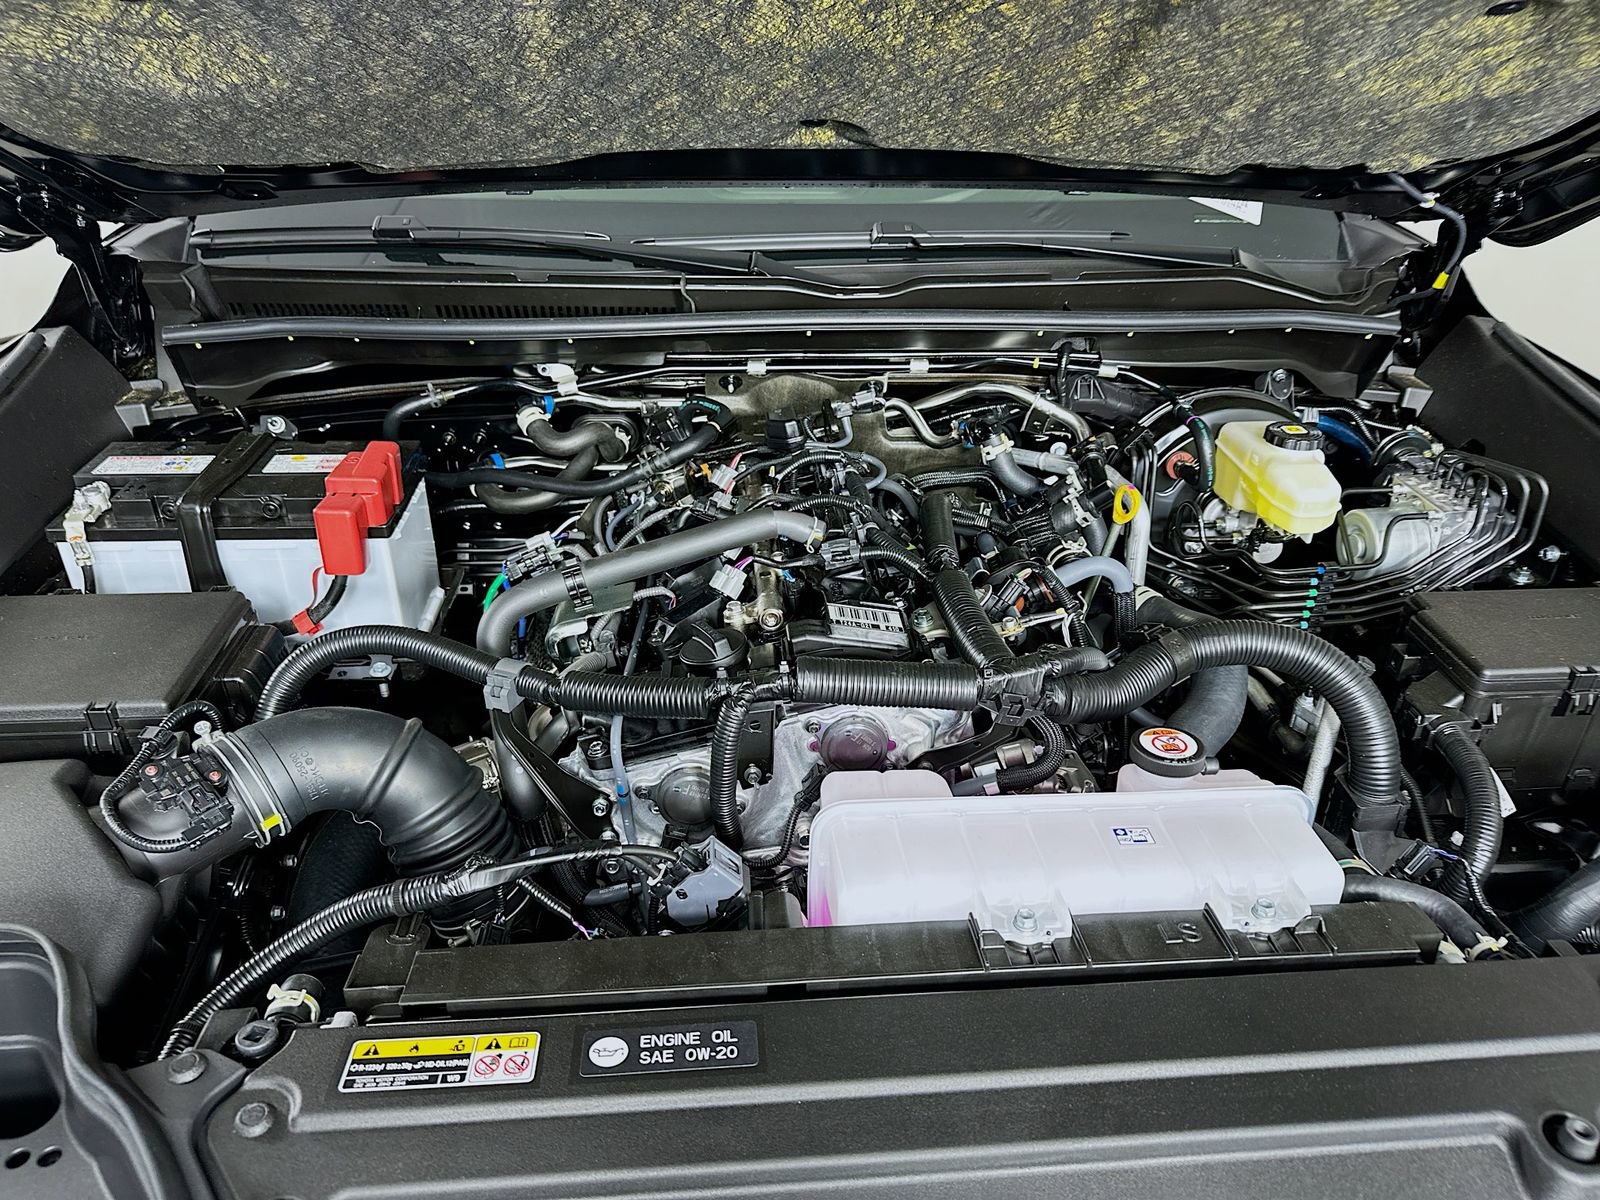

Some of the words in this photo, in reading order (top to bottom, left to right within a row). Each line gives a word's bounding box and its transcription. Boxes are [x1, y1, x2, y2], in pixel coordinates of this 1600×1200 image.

[1157, 922, 1202, 943] LS
[640, 1032, 700, 1048] ENGINE
[711, 1030, 738, 1043] OIL
[639, 1050, 674, 1065] SAE
[685, 1046, 738, 1061] 0W-20
